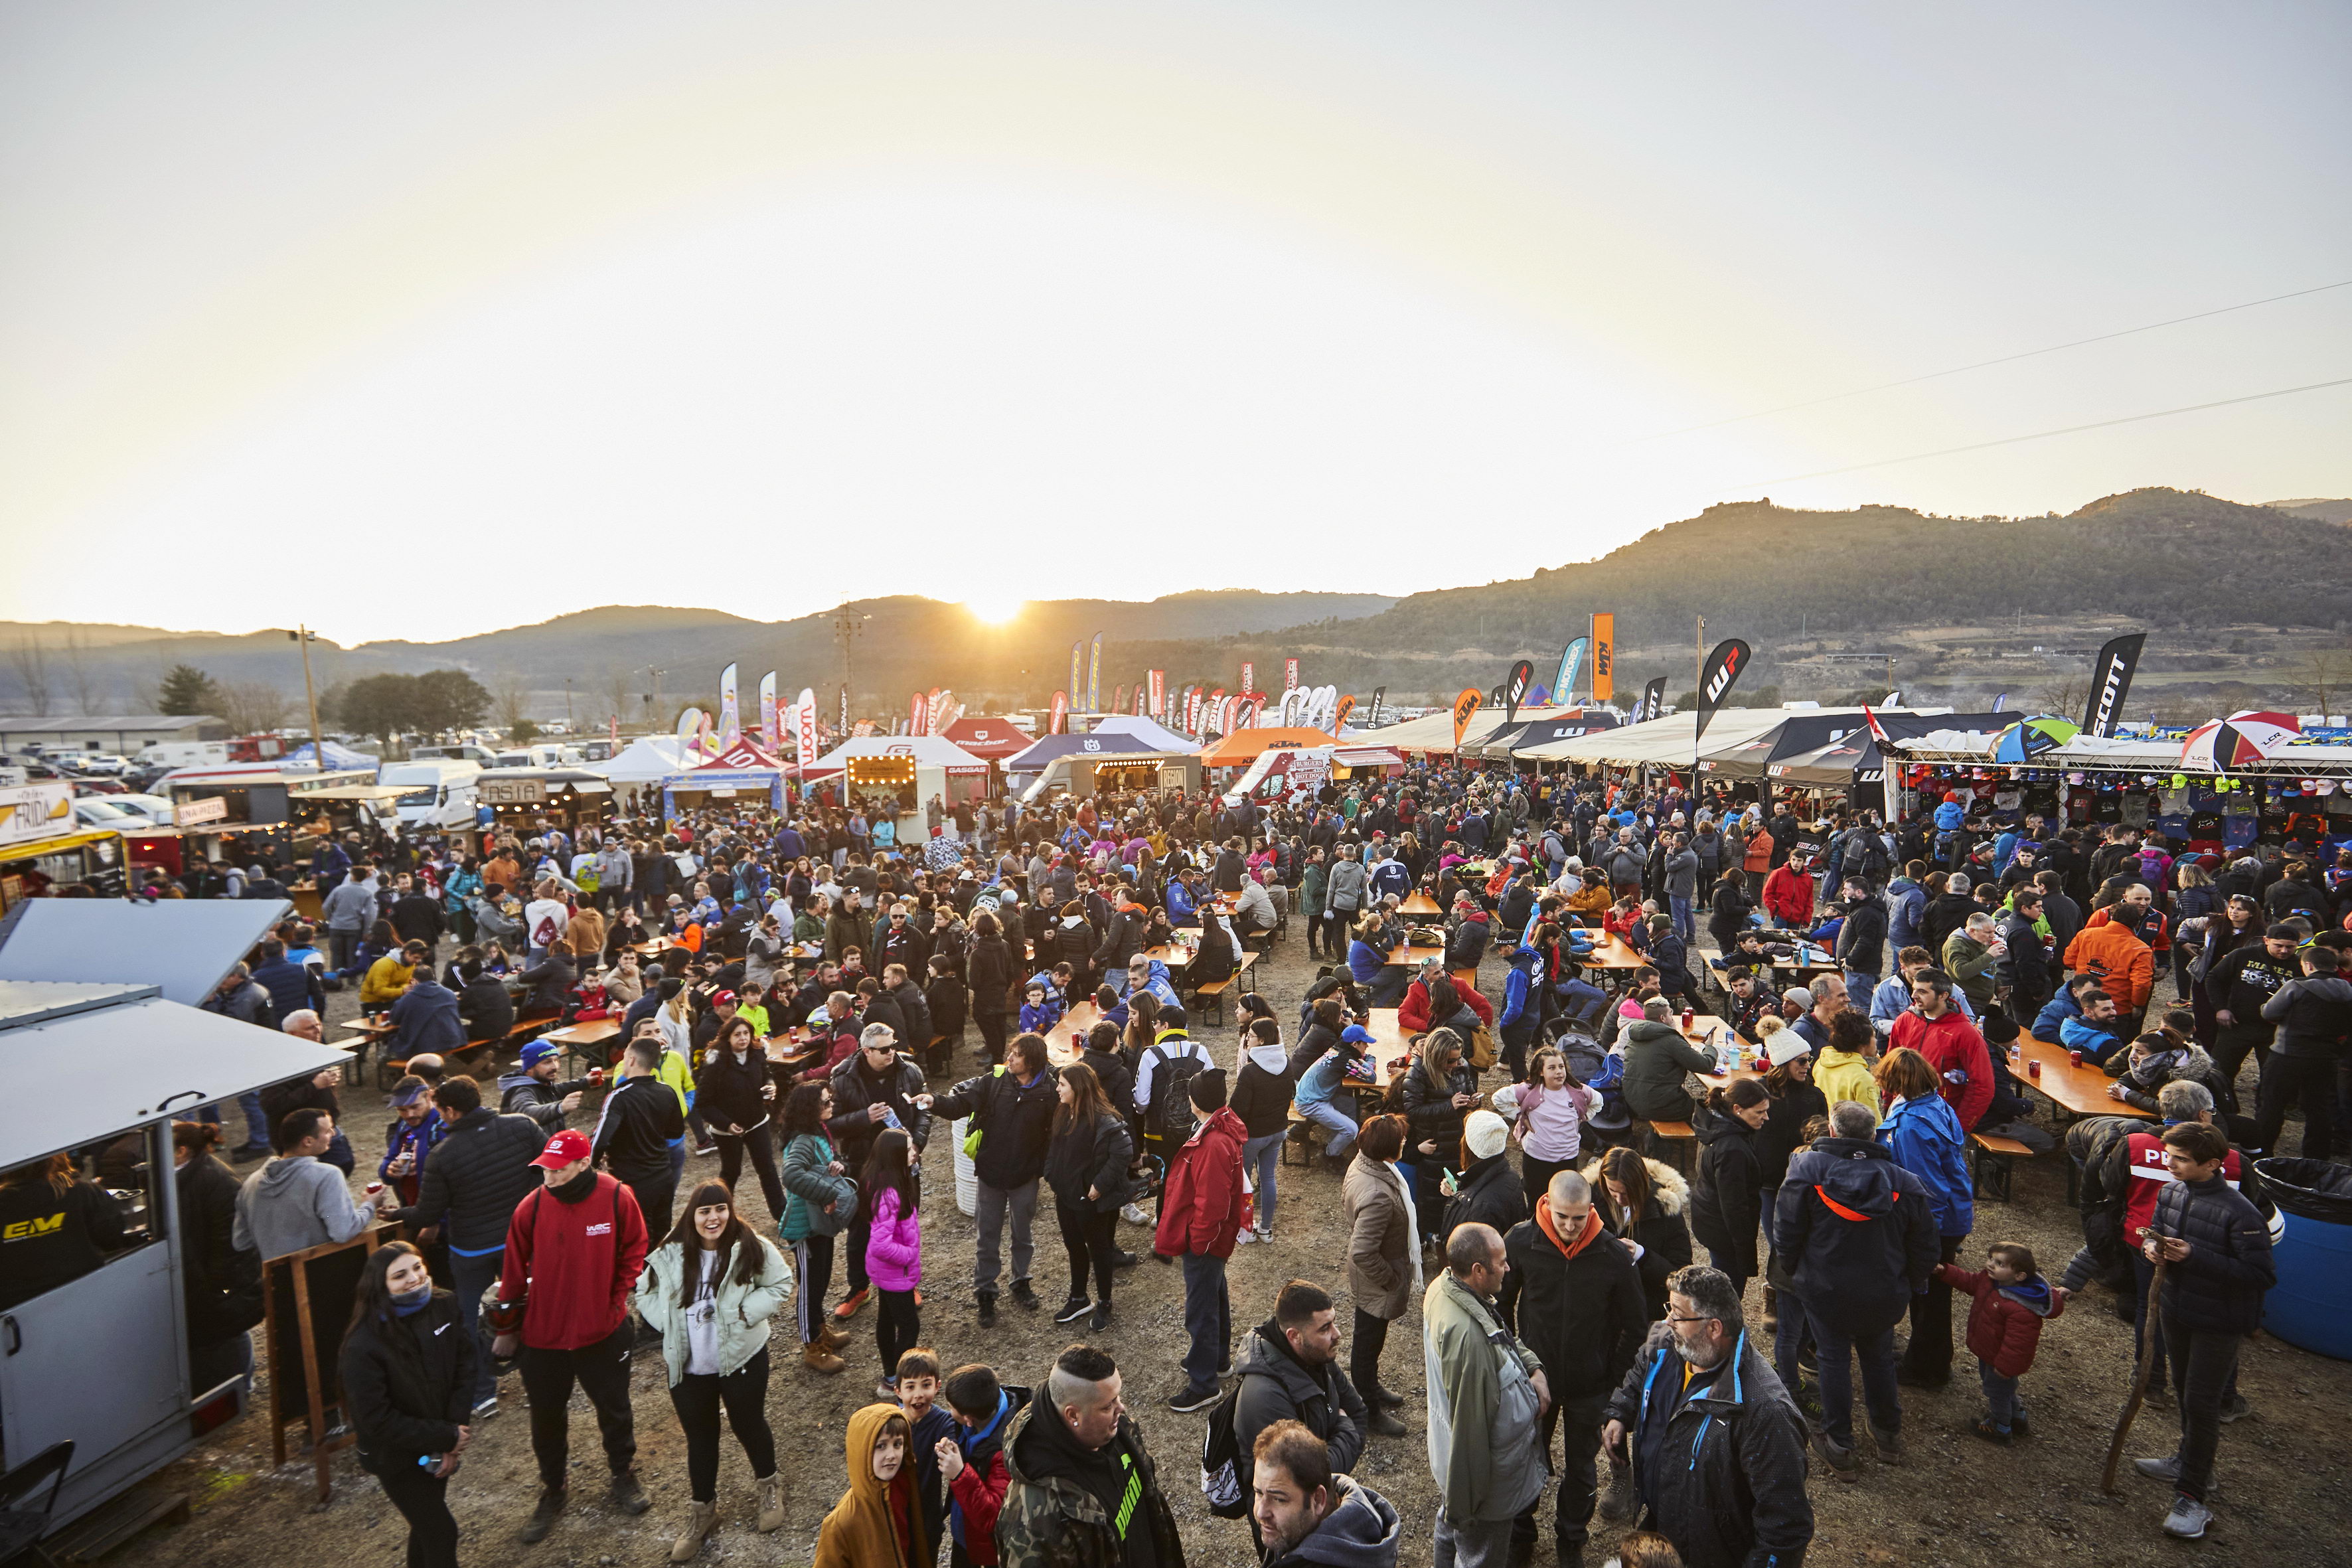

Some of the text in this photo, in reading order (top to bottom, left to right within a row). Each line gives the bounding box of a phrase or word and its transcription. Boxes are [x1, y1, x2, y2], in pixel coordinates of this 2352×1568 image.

[1560, 645, 1581, 688] MOTOREX
[1599, 641, 1610, 676] KTM
[1089, 642, 1099, 710] SHERCO
[1510, 665, 1528, 704] WP
[1707, 647, 1740, 704] WP
[1337, 700, 1353, 722] KTM
[1372, 692, 1381, 722] SCOTT
[1456, 694, 1478, 727] KTM
[1648, 688, 1658, 722] OTT
[2093, 653, 2126, 738] SCOTT
[927, 695, 937, 737] MOTUL
[1190, 694, 1201, 730] MOTUL
[2263, 732, 2282, 745] LCR
[2267, 736, 2288, 749] HONDA
[1163, 769, 1184, 787] REGION
[1859, 770, 1884, 782] W
[489, 785, 535, 801] ASIA
[15, 799, 52, 830] FRIDA
[179, 803, 222, 820] UNA PIZZA
[586, 1223, 611, 1231] WRC
